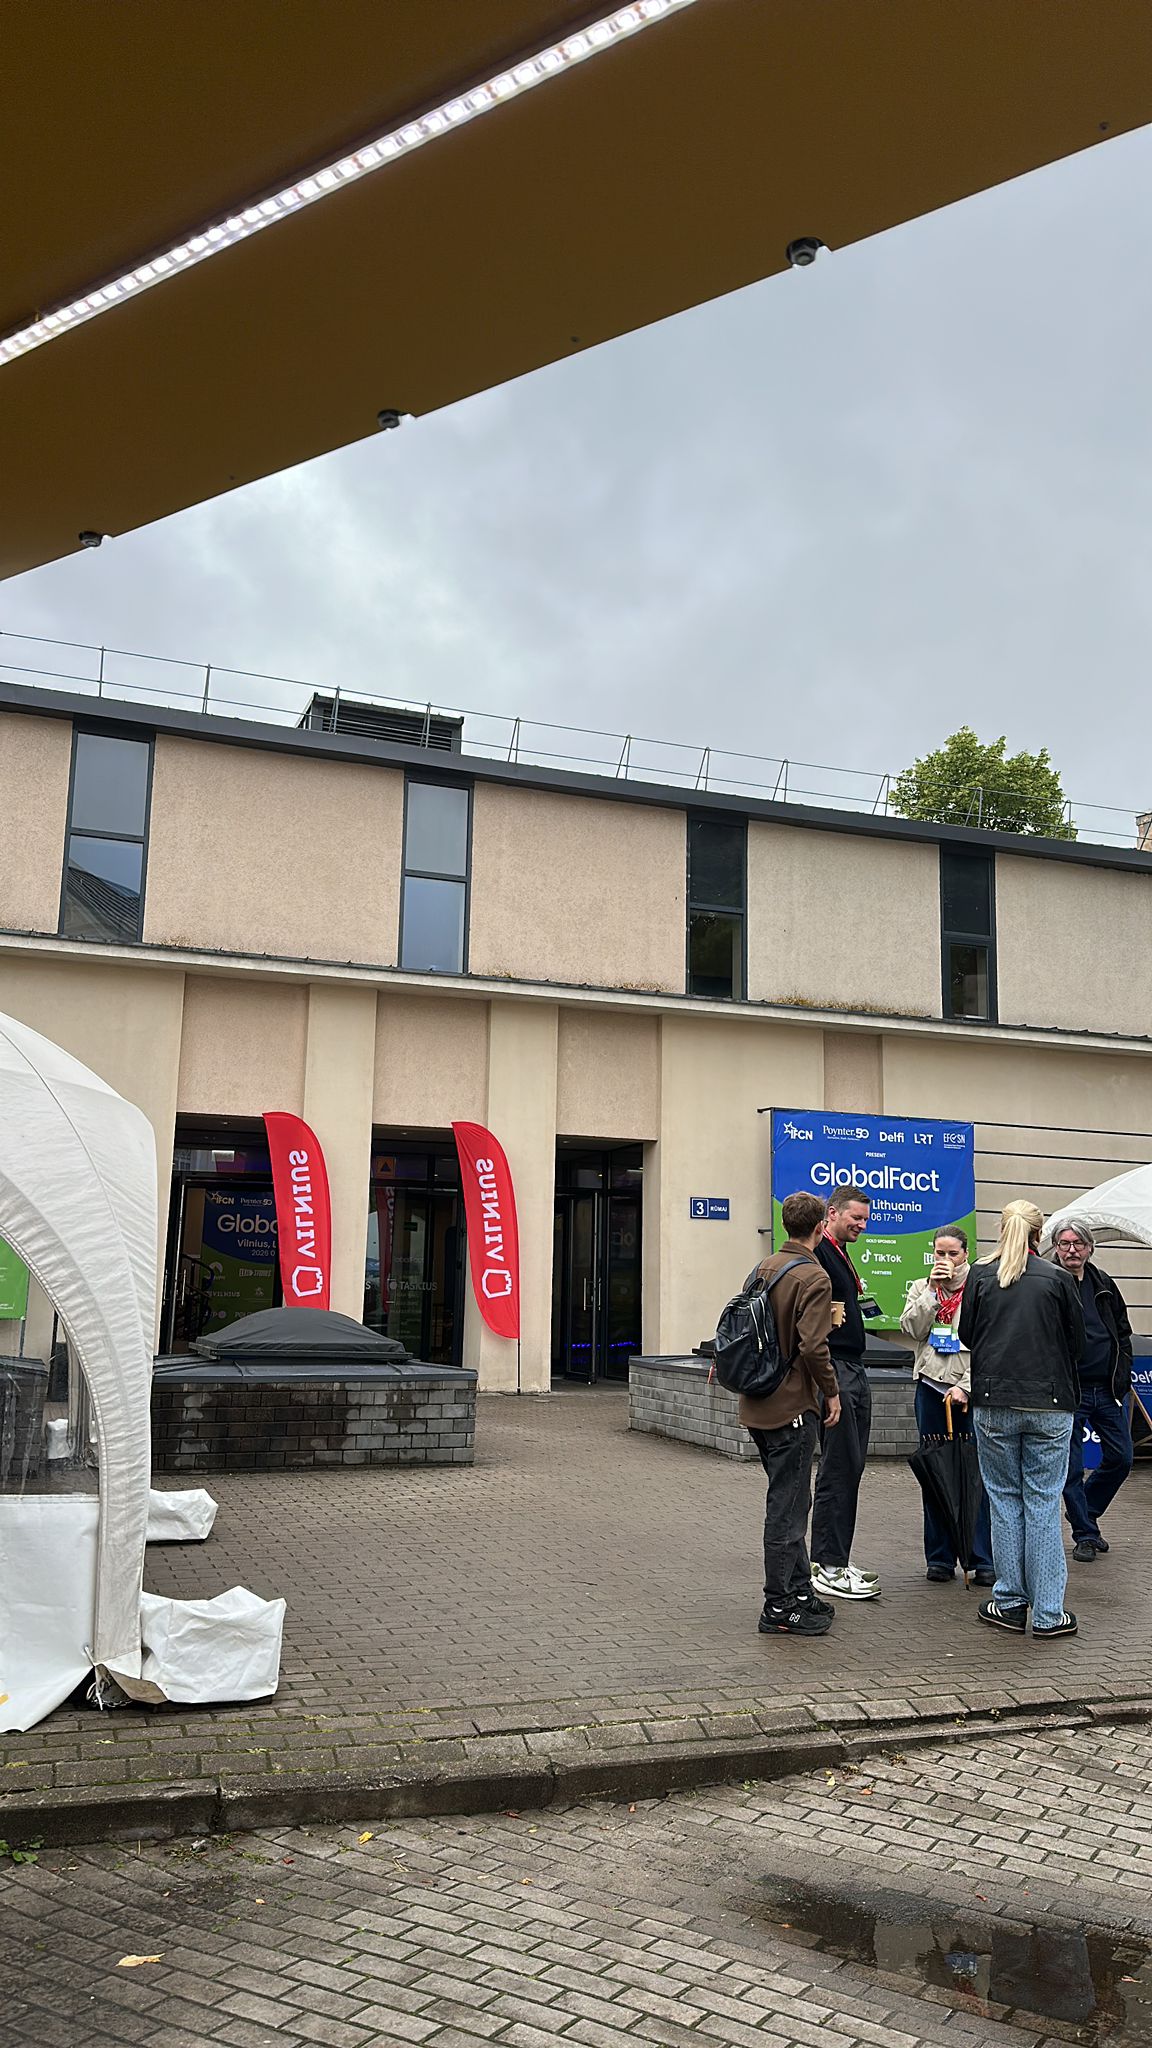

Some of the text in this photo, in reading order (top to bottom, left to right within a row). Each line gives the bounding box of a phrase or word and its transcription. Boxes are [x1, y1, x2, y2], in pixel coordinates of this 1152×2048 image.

[790, 1128, 813, 1141] IFCN
[879, 1132, 905, 1143] Delfi
[914, 1133, 934, 1145] LRT
[810, 1162, 940, 1192] GlobalFact
[696, 1202, 704, 1215] 3
[872, 1199, 922, 1213] Lithuania
[871, 1213, 903, 1223] 06 17-19
[873, 1253, 902, 1263] TikTok
[1130, 1370, 1152, 1384] Delf
